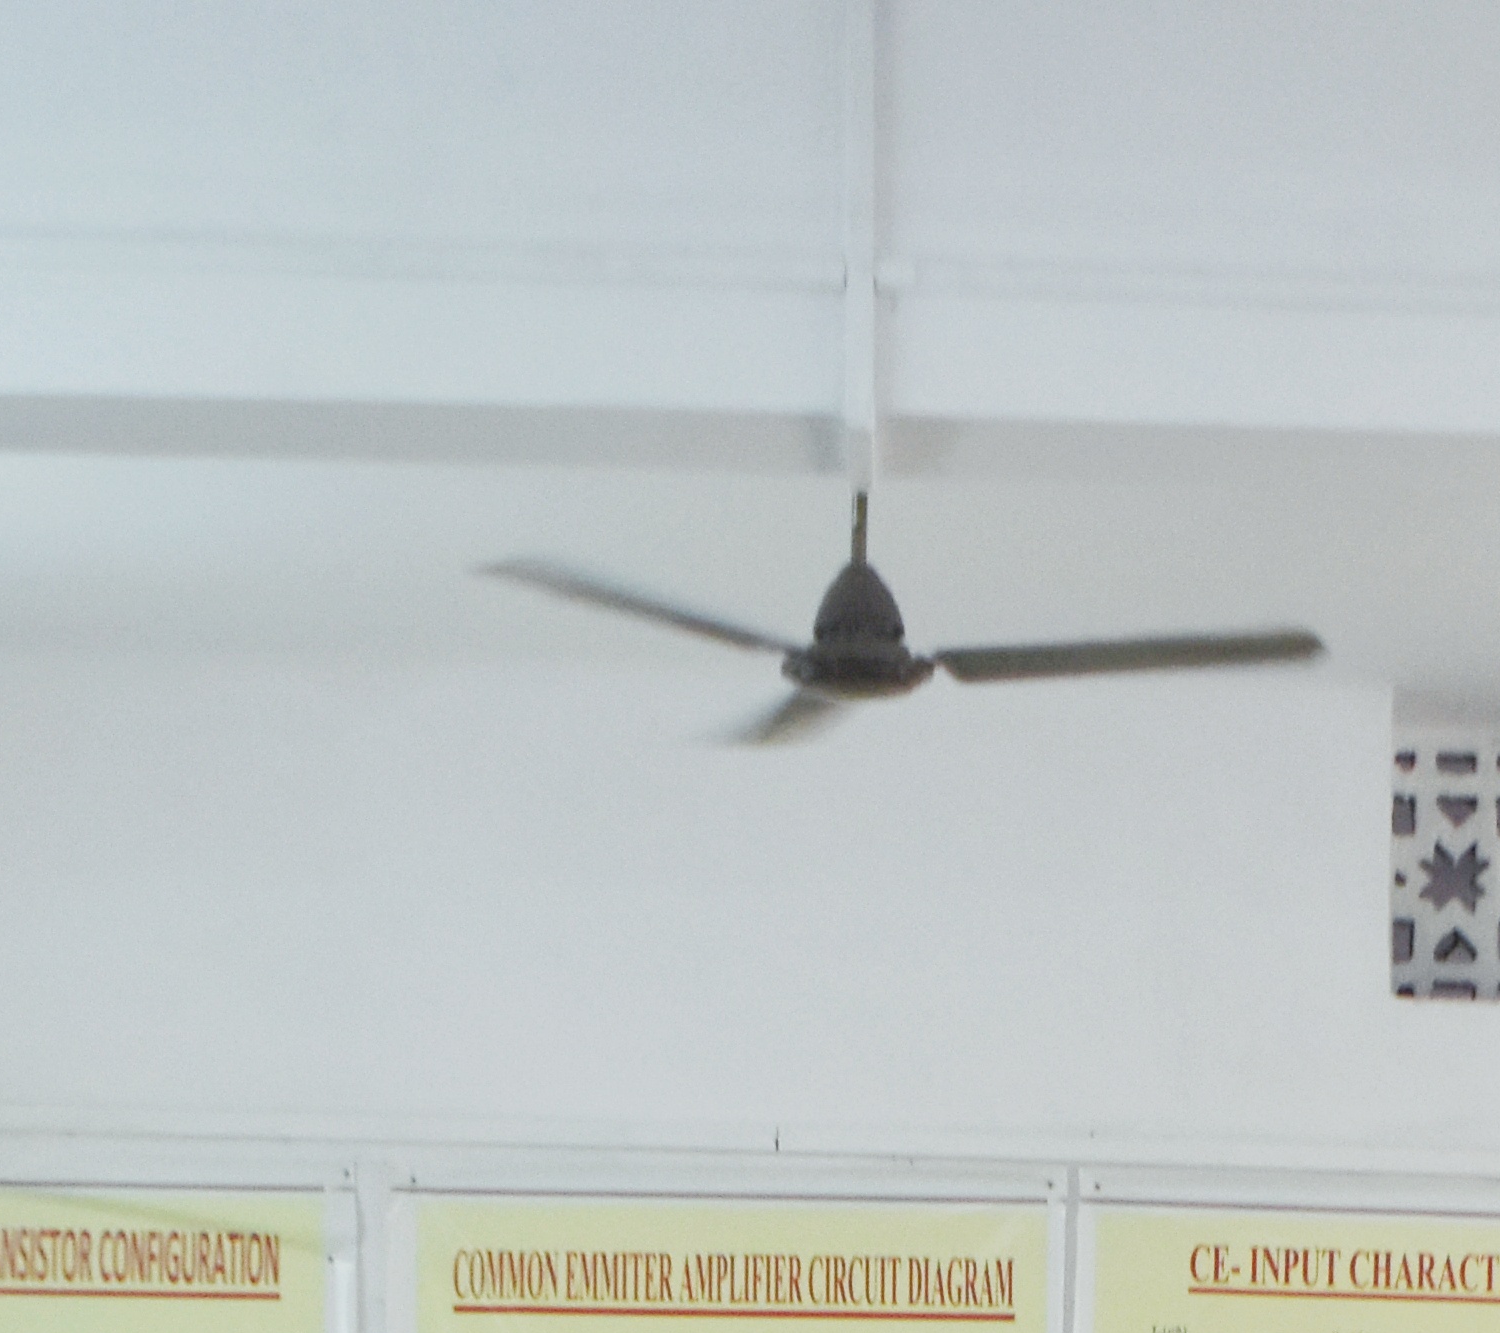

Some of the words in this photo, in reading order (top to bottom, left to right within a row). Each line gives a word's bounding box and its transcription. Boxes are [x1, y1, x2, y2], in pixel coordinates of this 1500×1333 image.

[100, 1230, 280, 1285] CONFIGURATION
[453, 1248, 558, 1301] COMMON
[566, 1250, 673, 1302] EMMITER
[681, 1252, 802, 1305] AMPLIFIER
[808, 1254, 901, 1306] CIRCUIT
[908, 1257, 1014, 1308] DIAGRAM
[1189, 1243, 1241, 1285] CE-
[1249, 1245, 1342, 1288] INPUT
